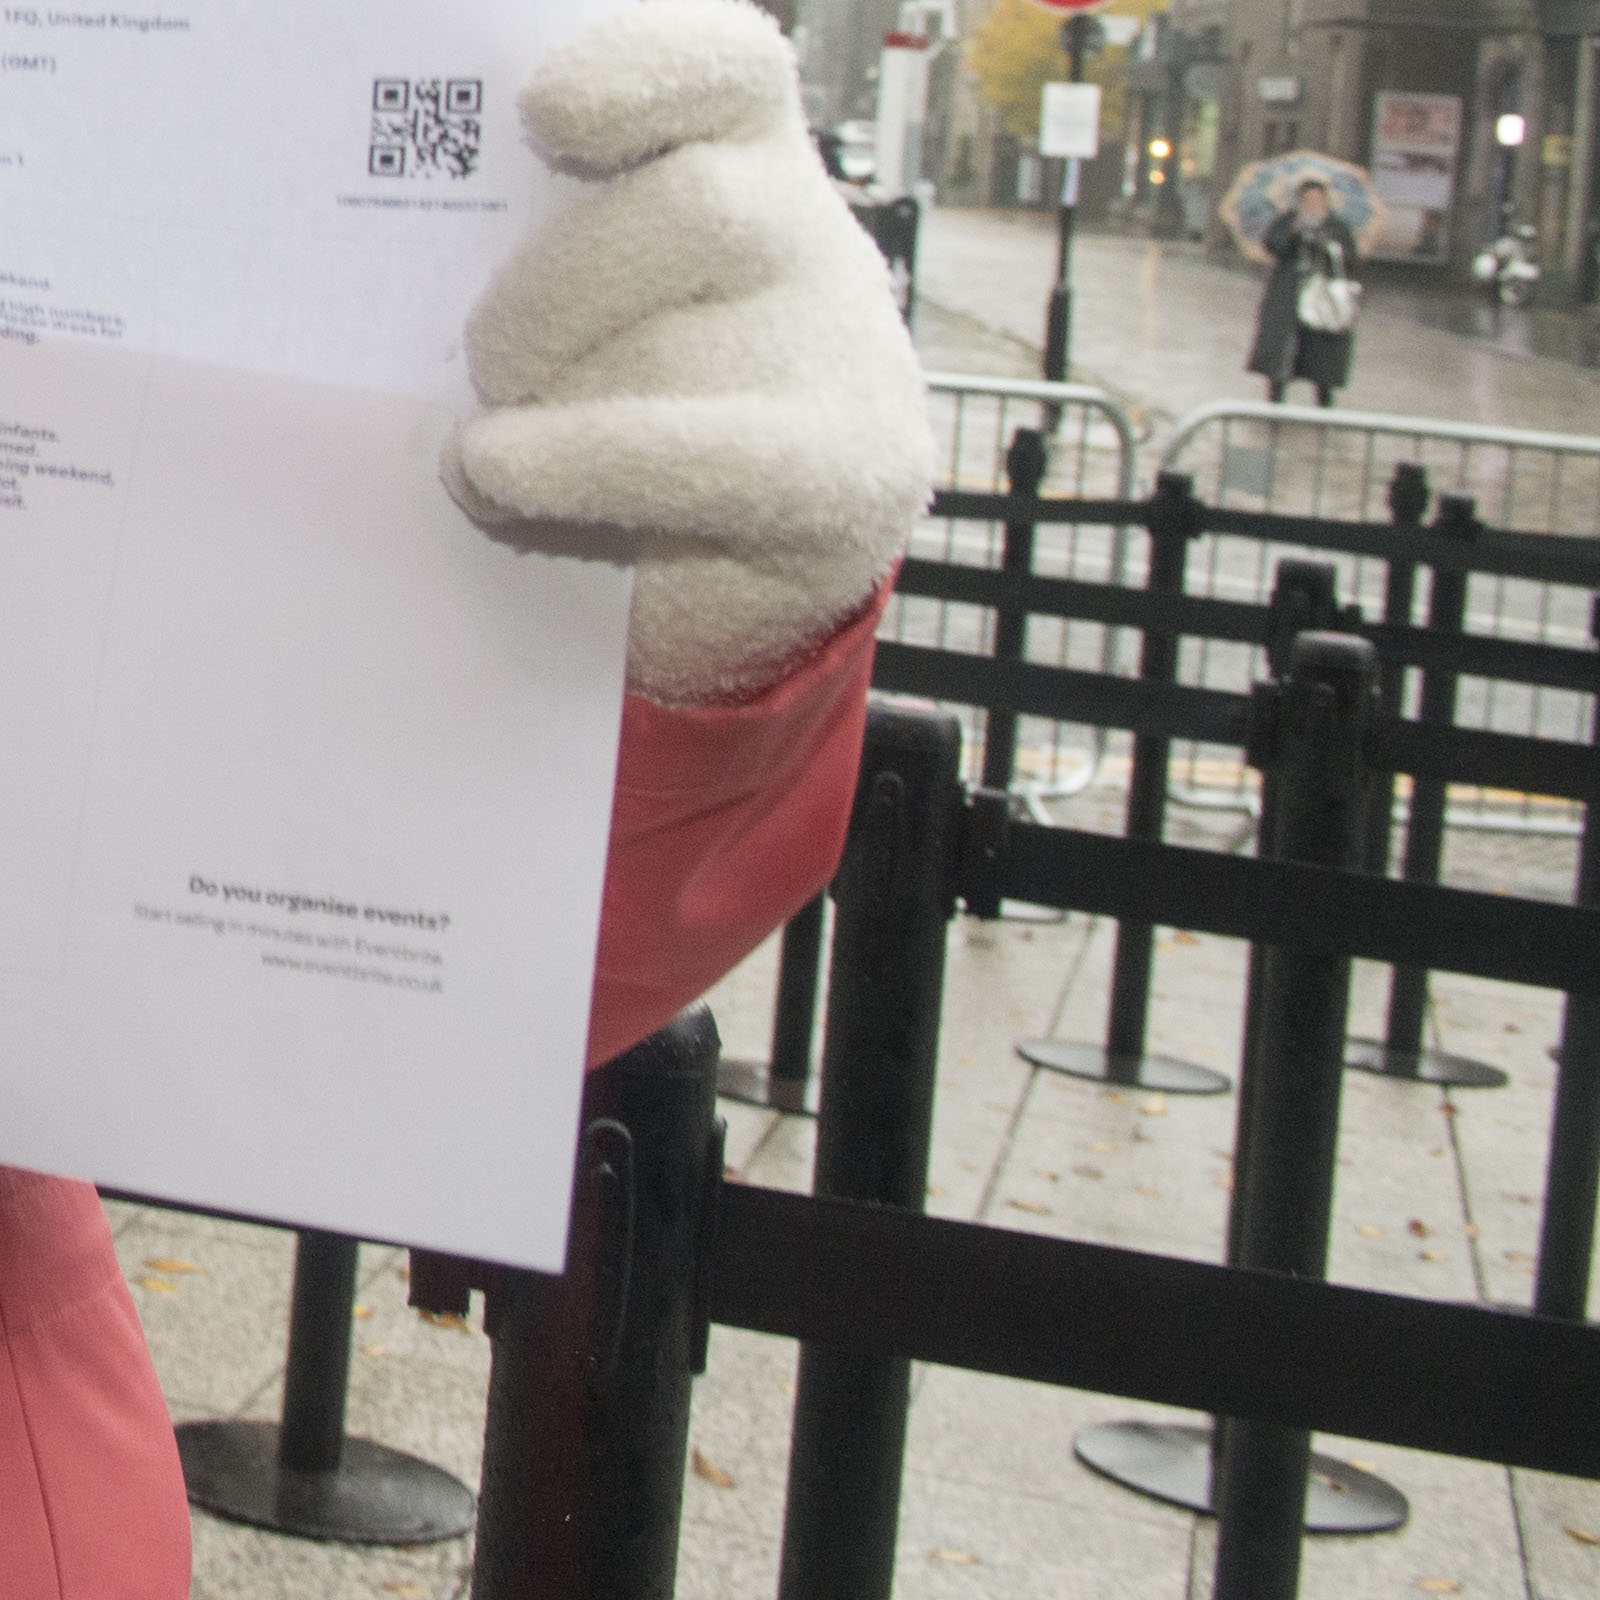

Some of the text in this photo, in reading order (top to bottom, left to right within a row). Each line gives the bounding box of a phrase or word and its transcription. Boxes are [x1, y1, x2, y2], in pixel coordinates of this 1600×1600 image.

[47, 12, 106, 28] United
[110, 13, 190, 33] Kingdom
[189, 873, 451, 931] Do you organise events?
